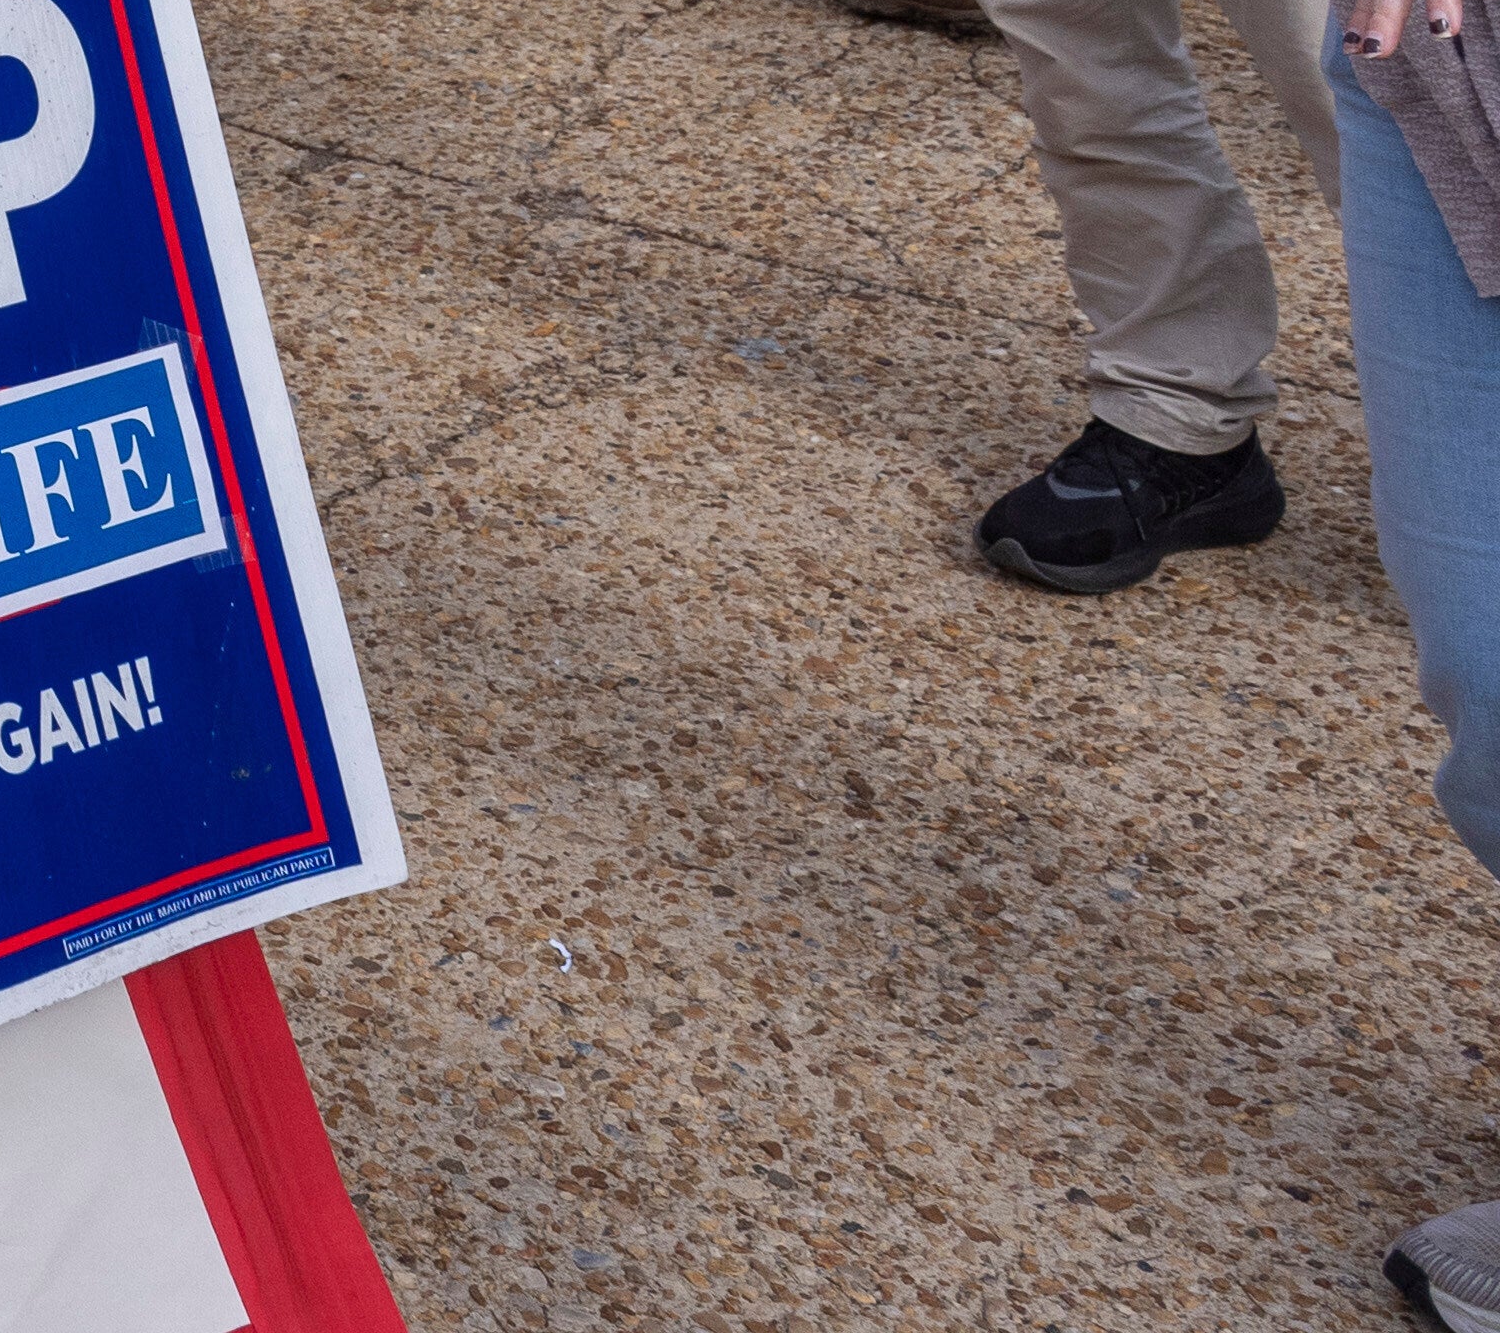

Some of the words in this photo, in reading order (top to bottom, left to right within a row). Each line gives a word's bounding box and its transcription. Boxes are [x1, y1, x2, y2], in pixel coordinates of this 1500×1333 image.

[68, 936, 95, 955] PAID
[95, 926, 118, 944] FOR
[118, 918, 134, 934] BY
[158, 887, 217, 919] MARYLAND
[218, 864, 289, 895] REPUBLICAN
[290, 852, 329, 875] PARTY
